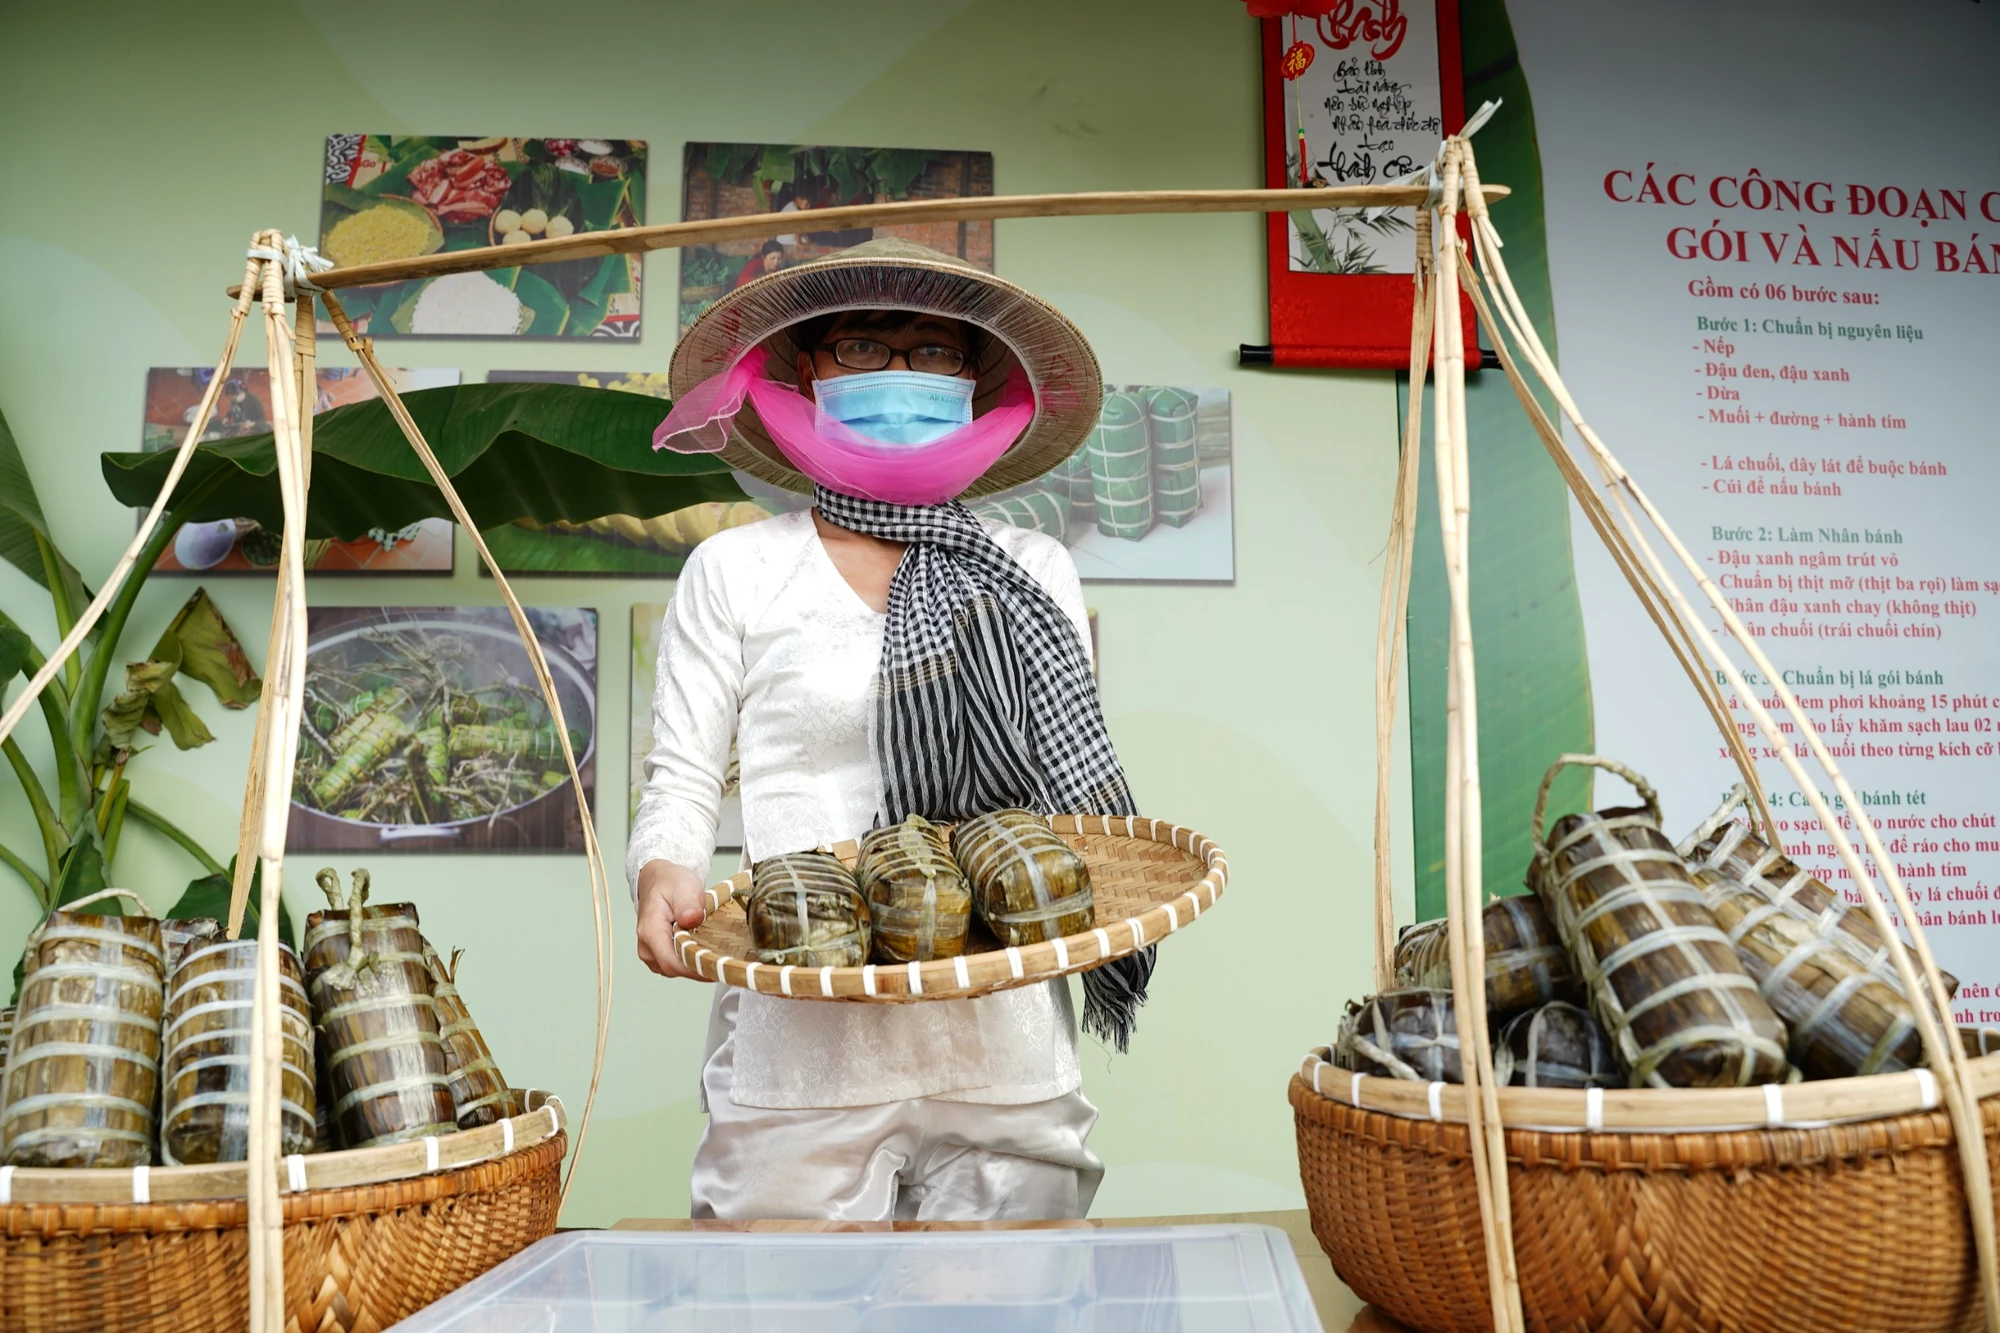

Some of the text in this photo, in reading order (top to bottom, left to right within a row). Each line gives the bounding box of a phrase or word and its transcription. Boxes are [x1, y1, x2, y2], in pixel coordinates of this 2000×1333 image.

[1287, 48, 1307, 74] 福
[1603, 162, 1696, 205] CÁC
[1709, 168, 1836, 214] CÔNG
[1846, 184, 1967, 228] ĐOẠN
[1666, 219, 1749, 261] GÓI
[1759, 224, 1821, 266] VÀ
[1832, 228, 1921, 271] NẤU
[1687, 276, 1880, 305] Gồm có 06 bước sau:
[1697, 316, 1923, 343] Bước 1: Chuẩn bị nguyên liệu
[1703, 336, 1735, 358] Nếp
[1705, 362, 1850, 384] Đậu đen, đậu xanh
[1707, 385, 1740, 401] Dừa
[1709, 405, 1750, 424] Muối
[1770, 411, 1820, 430] đường
[1838, 413, 1877, 429] hành
[1881, 415, 1907, 429] tím
[1712, 455, 1733, 471] Lá
[1738, 453, 1786, 473] chuối,
[1789, 457, 1816, 475] dây
[1846, 455, 1864, 473] để
[1868, 459, 1905, 478] buộc
[1909, 461, 1948, 476] bánh
[1746, 476, 1765, 494] để
[1769, 476, 1798, 495] nấu
[1803, 481, 1842, 496] bánh
[1711, 526, 1903, 544] Bước 2: Làm Nhân bánh
[1718, 550, 1750, 568] Đậu
[1756, 551, 1794, 565] xanh
[1799, 552, 1842, 569] ngâm
[1846, 552, 1876, 567] trút
[1719, 570, 1773, 589] Chuẩn
[1778, 574, 1793, 593] bị
[1798, 574, 1824, 593] thịt
[1859, 576, 1891, 594] (thịt
[1896, 577, 1914, 591] ba
[1919, 577, 1947, 595] rọi)
[1951, 577, 1979, 591] làm
[1769, 598, 1798, 616] đậu
[1803, 599, 1841, 613] xanh
[1846, 600, 1881, 617] chay
[1886, 600, 1940, 618] (không
[1944, 600, 1977, 618] thịt)
[1771, 618, 1813, 637] chuối
[1818, 623, 1852, 640] (trái
[1857, 618, 1898, 637] chuối
[1903, 623, 1941, 640] chín)
[1782, 666, 1834, 685] Chuẩn
[1839, 670, 1854, 689] bị
[1859, 670, 1873, 685] lá
[1877, 670, 1900, 689] gói
[1905, 670, 1944, 685] bánh
[1829, 694, 1864, 713] phơi
[1868, 694, 1926, 713] khoảng
[1931, 694, 1948, 709] 15
[1952, 693, 1988, 713] phút
[1831, 714, 1854, 737] lấy
[1907, 718, 1941, 737] sạch
[1946, 718, 1969, 732] lau
[1974, 718, 1991, 732] 02
[1794, 743, 1808, 757] lá
[1860, 742, 1894, 757] theo
[1898, 741, 1935, 760] từng
[1938, 741, 1971, 756] kích
[1862, 790, 1901, 806] bánh
[1906, 789, 1926, 805] tét
[1887, 814, 1926, 829] nước
[1930, 813, 1958, 829] cho
[1962, 812, 1996, 828] chút
[1783, 841, 1811, 856] anh
[1890, 834, 1908, 853] để
[1912, 838, 1938, 853] ráo
[1943, 838, 1970, 853] cho
[1897, 863, 1936, 878] hành
[1941, 862, 1967, 877] tím
[1928, 886, 1942, 901] lá
[1946, 881, 1988, 901] chuối
[1948, 910, 1987, 925] bánh
[1962, 983, 1990, 998] nên
